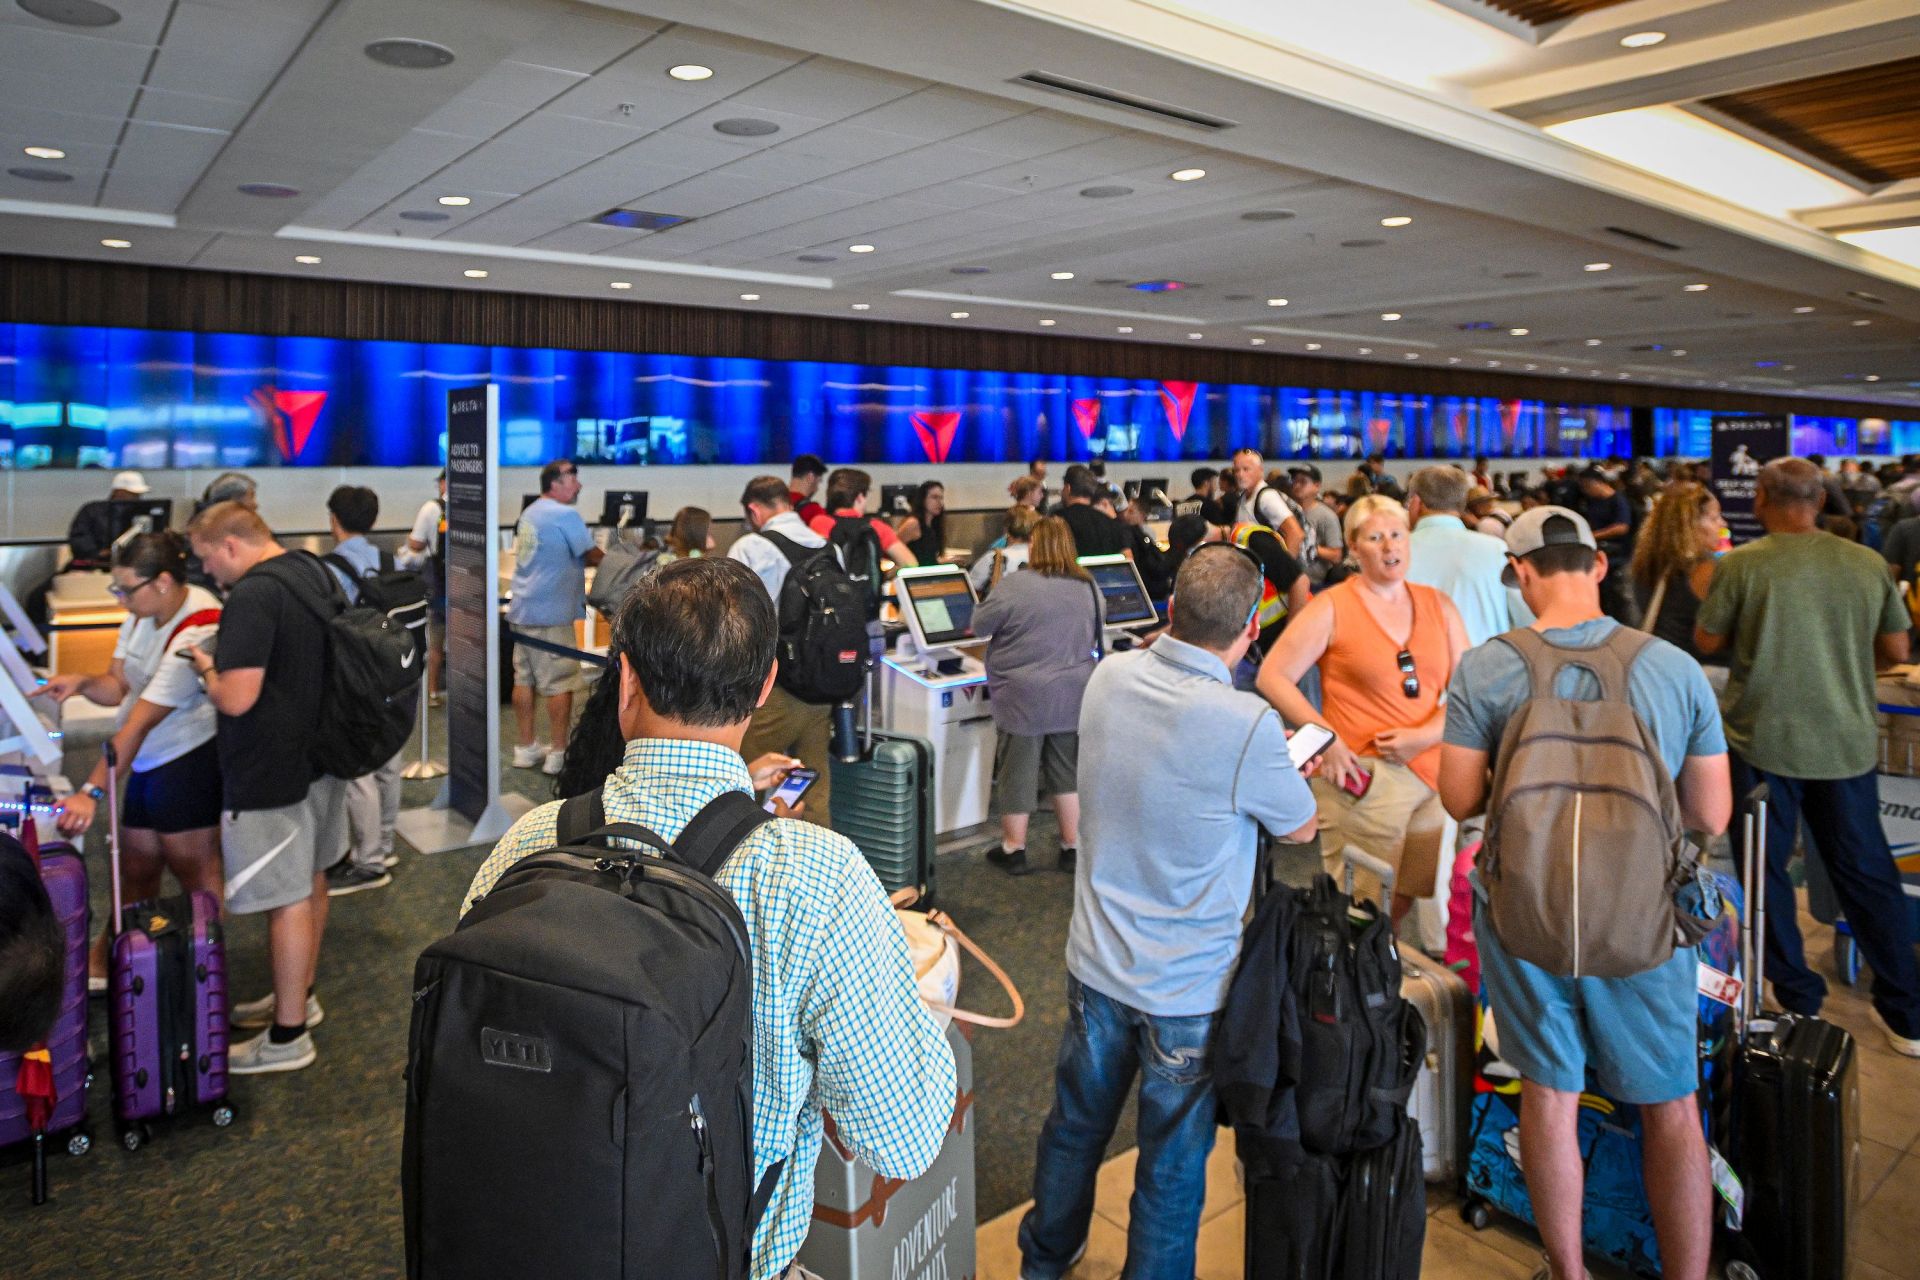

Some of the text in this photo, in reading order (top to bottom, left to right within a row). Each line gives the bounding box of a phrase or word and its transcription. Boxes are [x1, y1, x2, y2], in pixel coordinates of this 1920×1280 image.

[457, 399, 477, 413] DELTA
[451, 443, 479, 457] ADVICE TO
[450, 459, 483, 473] PASSENGERS
[489, 1037, 538, 1063] YETI
[891, 1176, 957, 1280] ADVENTURE
